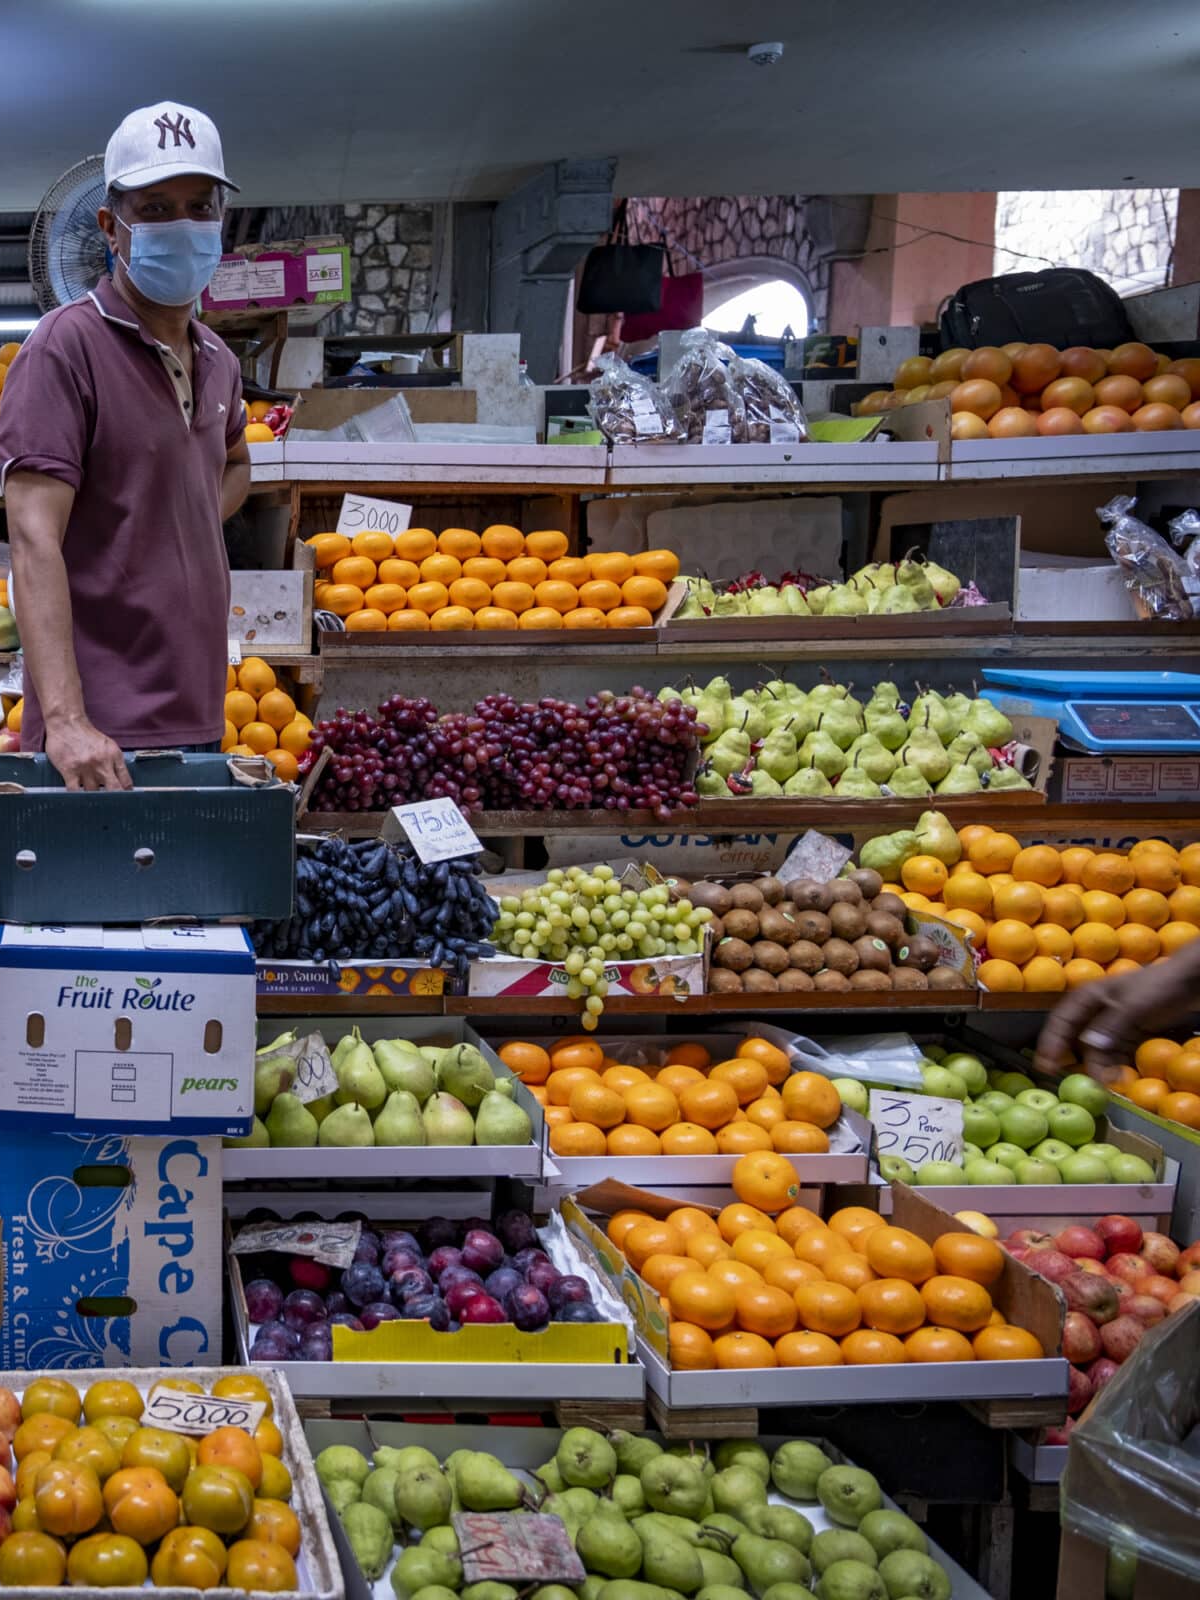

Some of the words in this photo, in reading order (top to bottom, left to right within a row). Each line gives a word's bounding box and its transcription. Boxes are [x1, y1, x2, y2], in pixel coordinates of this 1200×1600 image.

[719, 849, 768, 864] citrus
[74, 975, 99, 988] the
[293, 970, 329, 985] honey
[56, 986, 113, 1010] Fruit
[121, 987, 195, 1011] Route
[179, 1075, 239, 1095] pears
[880, 1096, 913, 1127] 3
[143, 1138, 209, 1296] Cape
[11, 1215, 30, 1275] Fresh
[12, 1284, 29, 1303] &
[147, 1395, 249, 1425] 50.00
